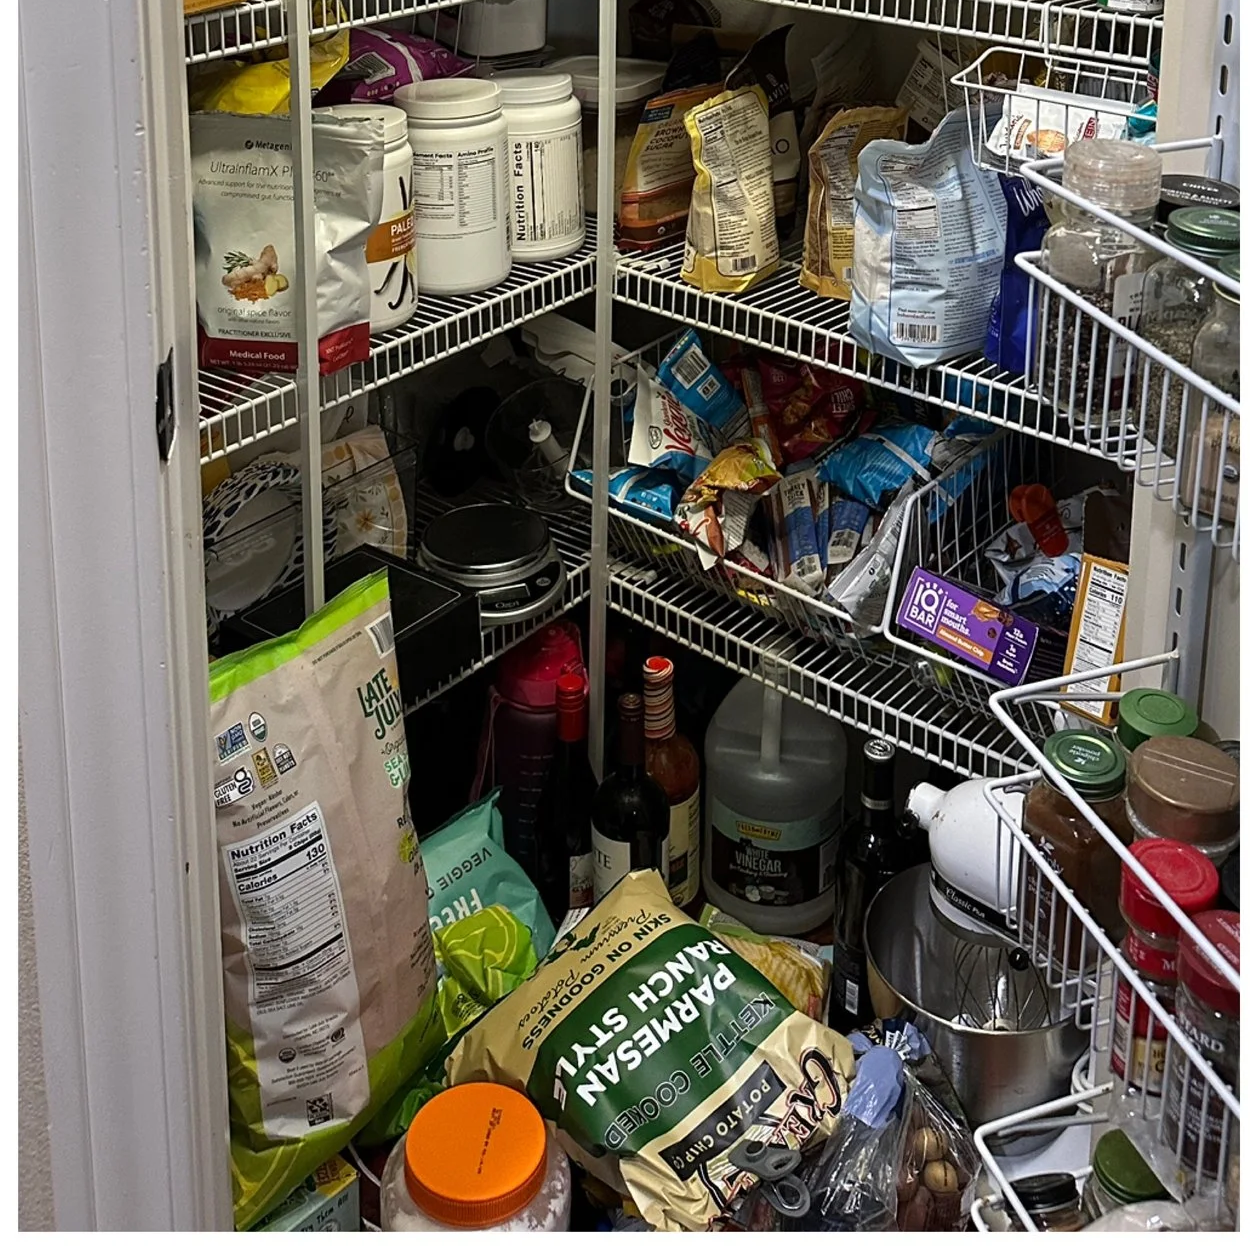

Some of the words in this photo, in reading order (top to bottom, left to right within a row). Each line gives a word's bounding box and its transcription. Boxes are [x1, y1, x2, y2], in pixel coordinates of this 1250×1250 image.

[255, 140, 292, 151] Metageni
[514, 142, 522, 177] Facts
[1183, 182, 1219, 192] CHIVES
[515, 184, 525, 241] Nutrition
[267, 307, 292, 317] flavor
[218, 329, 259, 338] PRACTITIONER
[260, 330, 292, 338] EXCLUSIVE
[229, 350, 262, 359] Medical
[263, 352, 286, 361] Food
[1093, 566, 1112, 578] Nutrition
[1113, 572, 1127, 583] Facts
[914, 583, 940, 615] IQ
[946, 598, 958, 610] for
[1089, 587, 1107, 599] Calories
[1110, 593, 1123, 604] 110
[909, 606, 935, 629] BAR
[940, 616, 971, 636] mouths.
[944, 608, 968, 626] smart
[939, 628, 956, 641] Almond
[956, 637, 973, 651] Butter
[972, 645, 985, 657] Chip
[356, 667, 392, 718] LATE
[231, 723, 242, 734] NON
[232, 731, 243, 740] GMO
[214, 781, 238, 798] GLUTEN
[217, 794, 232, 807] FREE
[232, 819, 241, 828] No
[241, 808, 265, 826] Artificial
[265, 800, 282, 817] Flavors,
[252, 798, 267, 811] Vegan
[256, 807, 290, 830] Preservatives
[231, 831, 287, 861] Nutrition
[289, 812, 318, 834] Facts
[233, 858, 249, 868] About
[258, 846, 280, 860] Servings
[234, 863, 258, 874] Serving
[258, 857, 271, 866] Size
[238, 873, 278, 892] Calories
[305, 843, 325, 861] 130
[735, 850, 782, 873] VINEGAR
[436, 847, 493, 891] VEGGIE
[944, 886, 973, 912] Classic
[577, 910, 653, 963] Premium
[633, 913, 671, 941] SKIN
[605, 940, 634, 963] ON
[628, 938, 732, 1012] RANCH
[515, 969, 579, 1031] Potatoes
[521, 961, 606, 1052] GOODNESS
[576, 962, 738, 1107] PARMESAN
[691, 991, 776, 1078] KETTLE
[552, 1006, 629, 1111] STYLE
[604, 1070, 691, 1150] COOKED
[716, 1079, 771, 1144] POTATO
[681, 1134, 716, 1168] CHIP
[316, 1207, 335, 1223] Them
